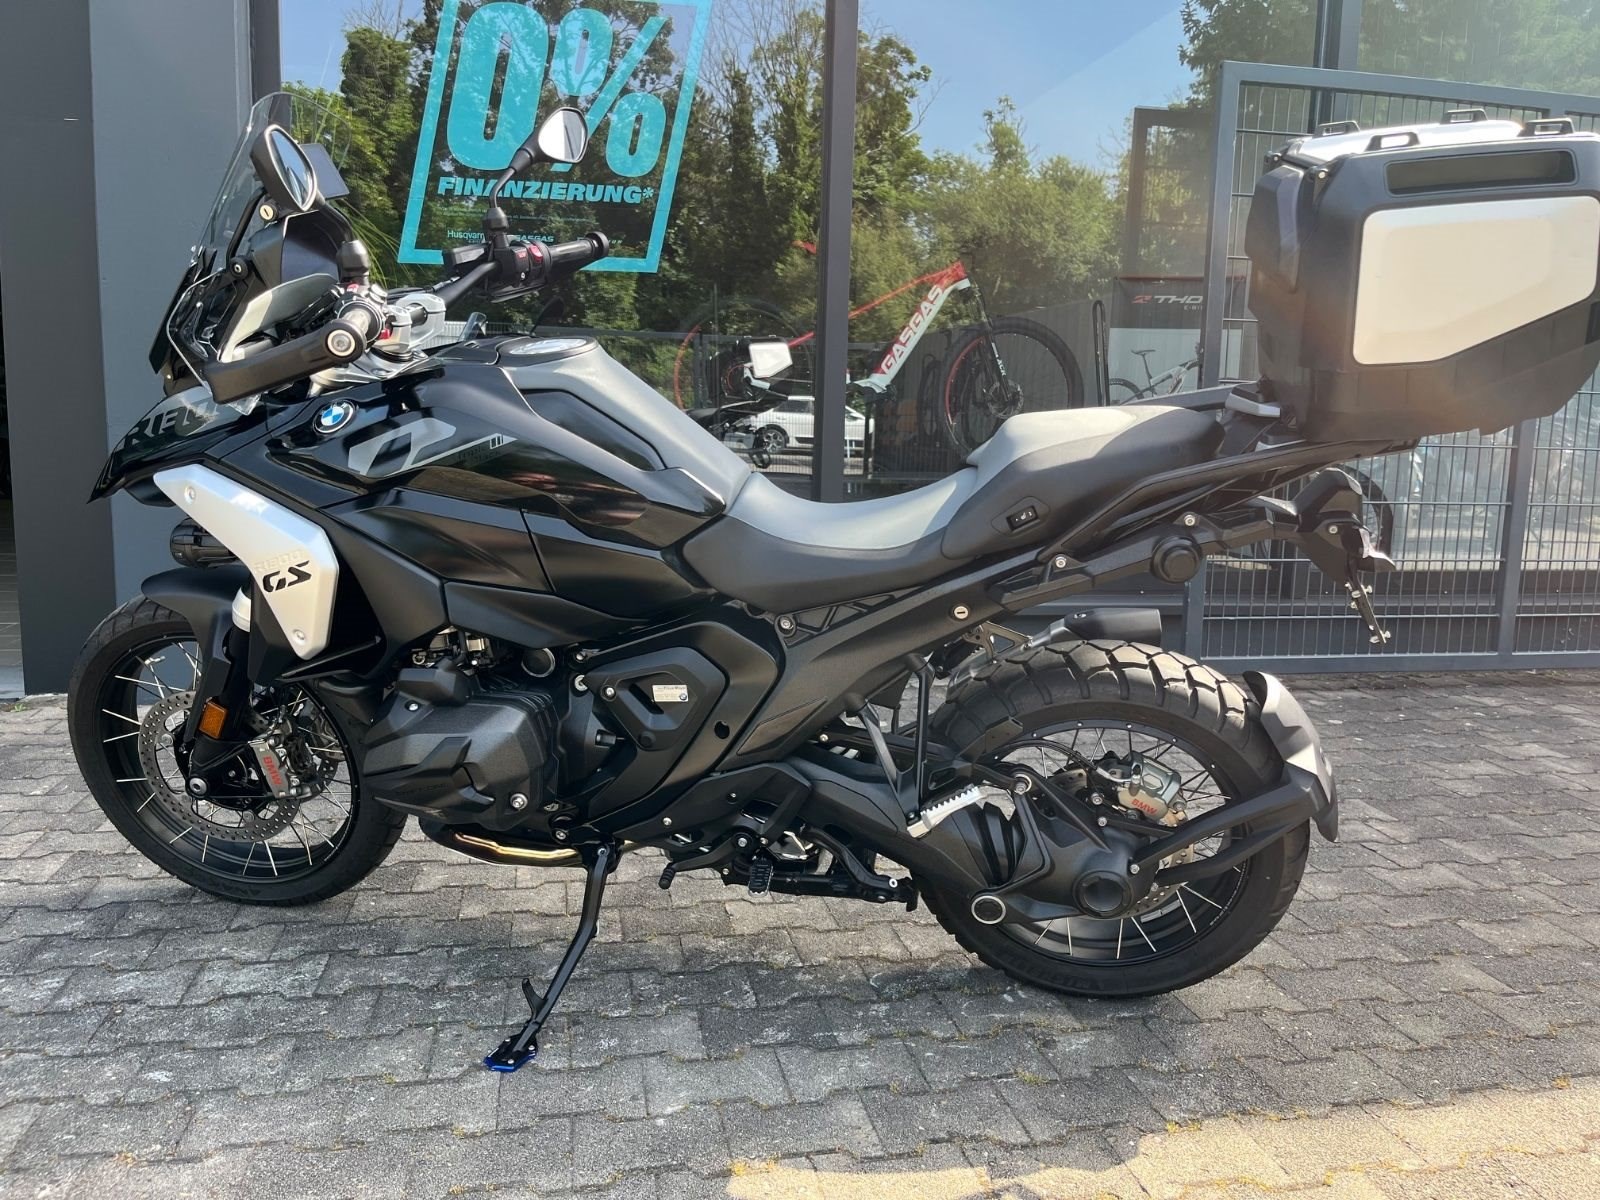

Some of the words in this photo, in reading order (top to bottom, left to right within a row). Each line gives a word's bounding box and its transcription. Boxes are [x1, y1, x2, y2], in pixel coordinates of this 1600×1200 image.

[446, 1, 668, 178] 0%
[447, 230, 486, 240] Husqvarn
[1153, 295, 1204, 304] THO
[880, 284, 943, 374] GASGAS
[262, 560, 312, 593] GS
[263, 755, 283, 785] BMW
[1131, 798, 1159, 815] BMW
